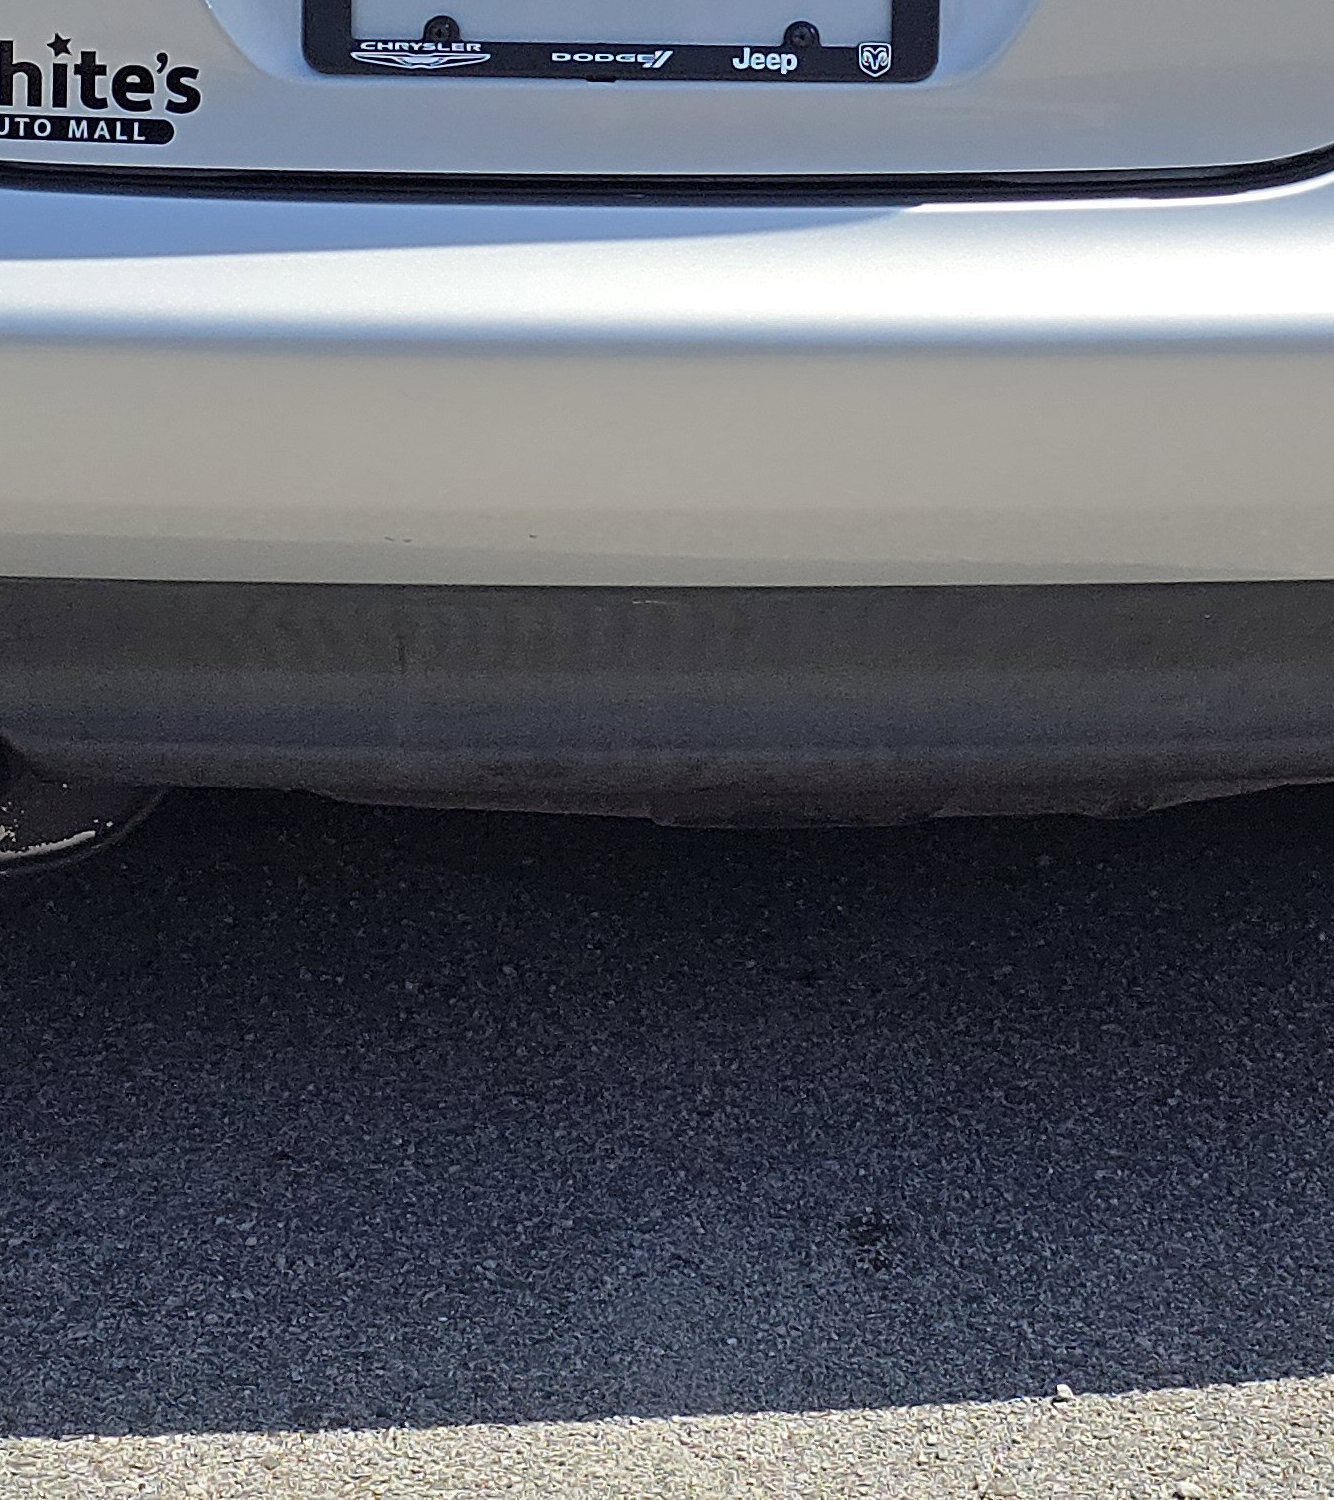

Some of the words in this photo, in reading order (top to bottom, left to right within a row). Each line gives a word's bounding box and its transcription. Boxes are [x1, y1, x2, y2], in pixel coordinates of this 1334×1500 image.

[359, 41, 482, 52] CHRYSLER
[551, 51, 655, 65] DODGE
[732, 47, 799, 75] Jeep
[68, 119, 147, 142] MALL
